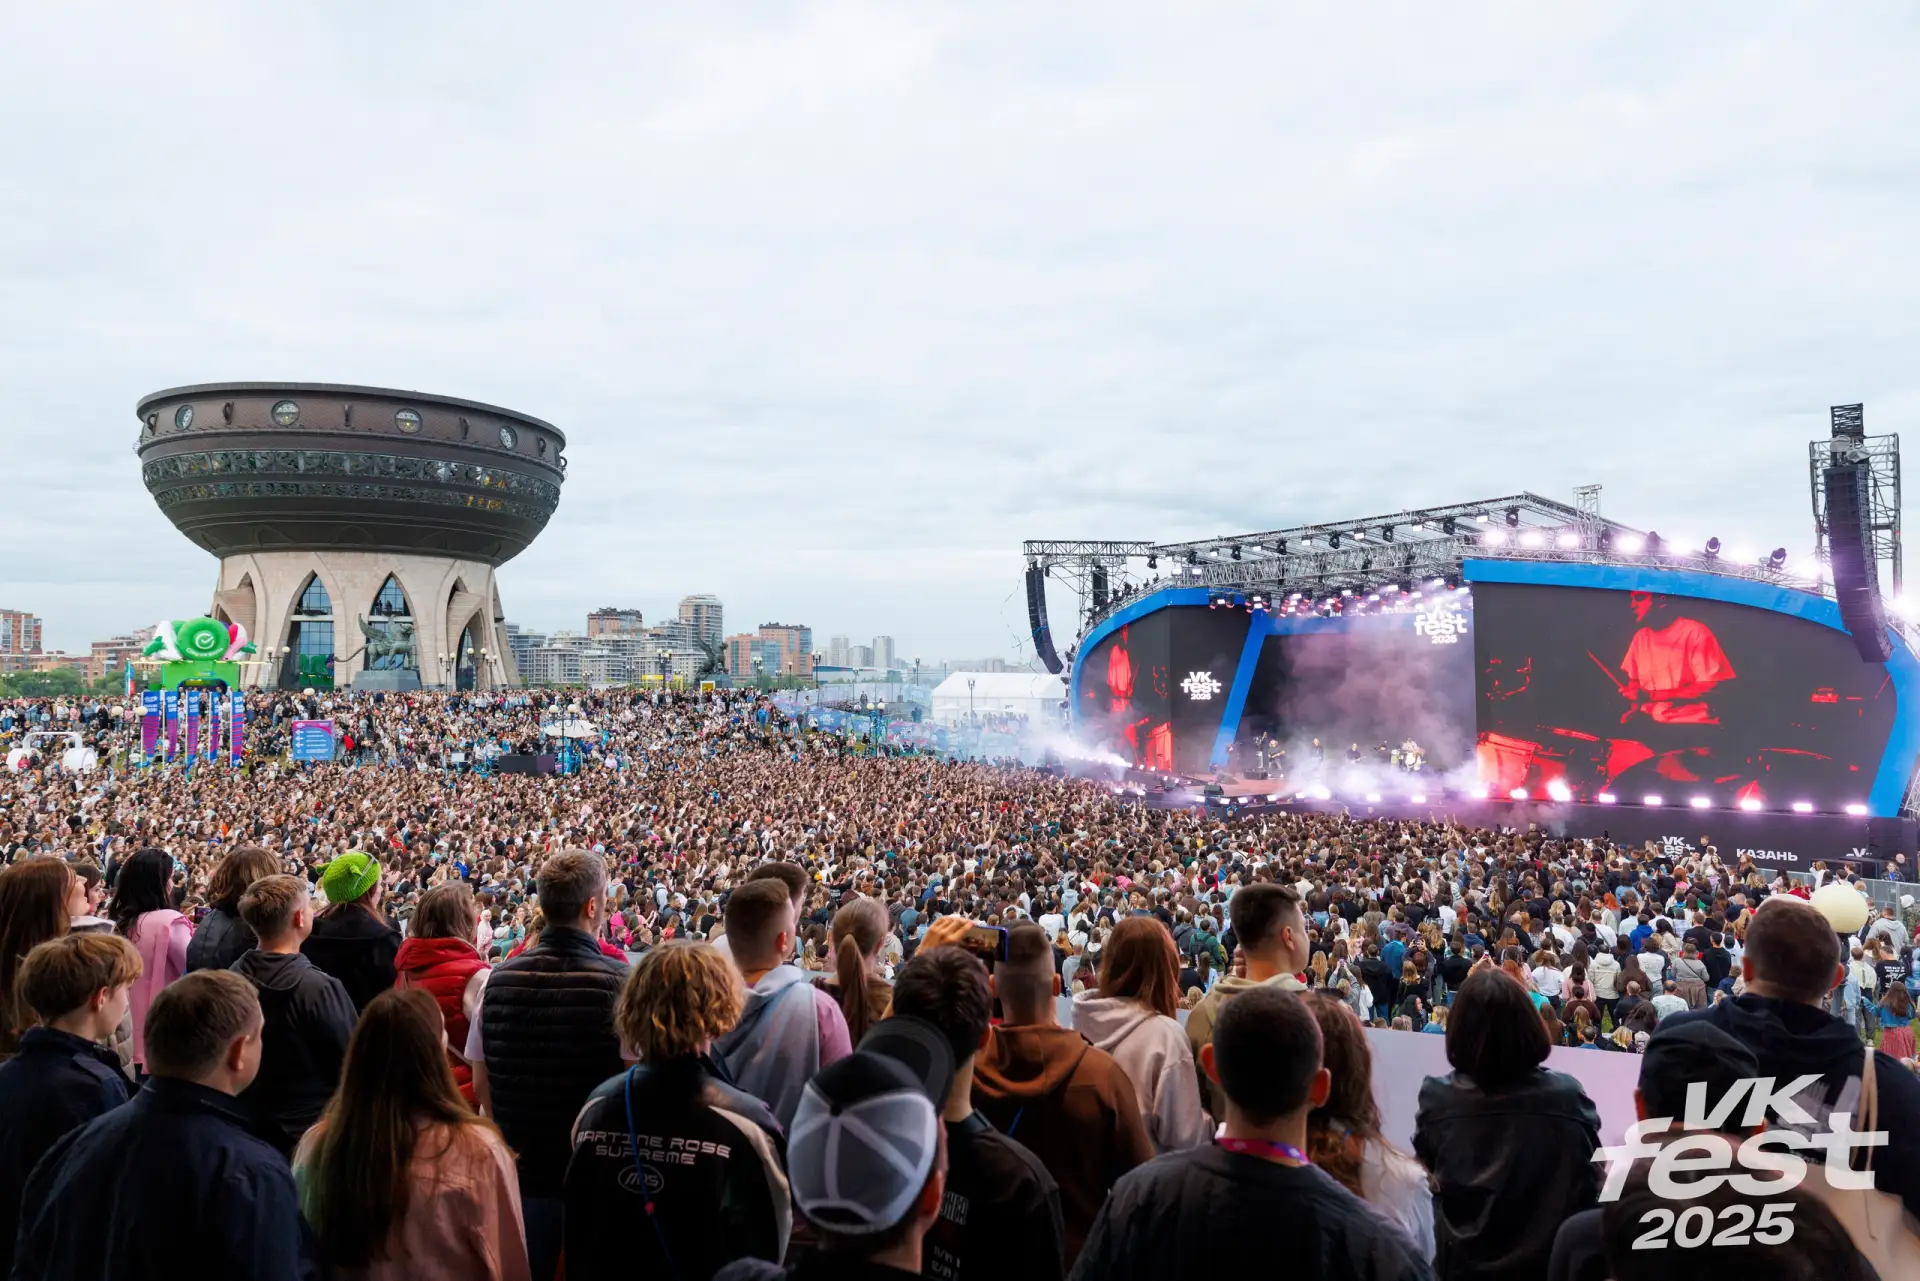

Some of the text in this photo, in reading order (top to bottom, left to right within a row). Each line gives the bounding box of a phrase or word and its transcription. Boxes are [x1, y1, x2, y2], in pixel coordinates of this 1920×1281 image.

[1413, 613, 1468, 636] fest
[1189, 671, 1212, 683] VK
[1180, 678, 1222, 693] fest
[1661, 835, 1685, 846] VK
[1736, 848, 1798, 861] КАЗАНЬ
[576, 1130, 732, 1159] MARTINE ROSE
[595, 1144, 696, 1165] SUPREME
